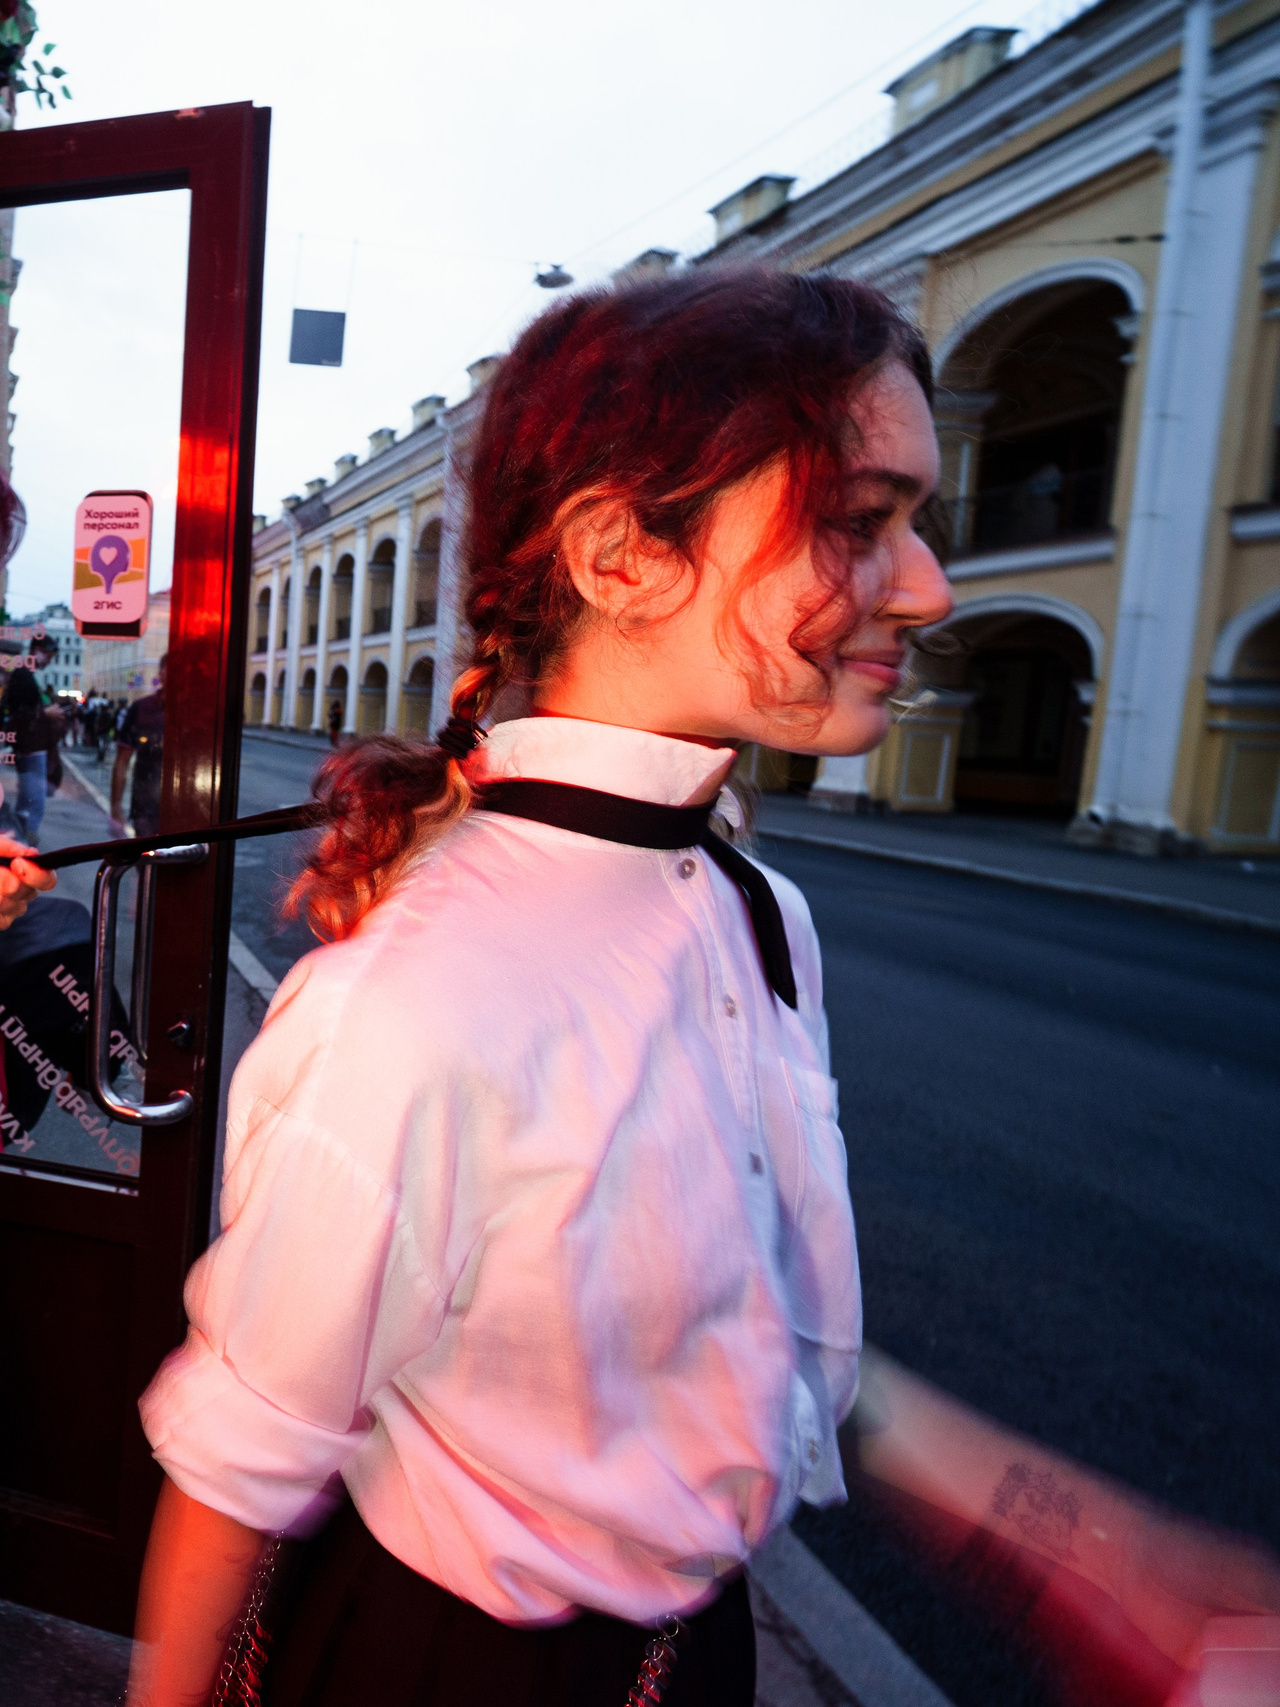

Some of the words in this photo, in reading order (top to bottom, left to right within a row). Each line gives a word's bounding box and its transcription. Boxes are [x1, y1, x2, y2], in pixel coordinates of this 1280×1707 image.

[84, 508, 139, 522] Хороший
[83, 521, 140, 532] персонал
[93, 600, 122, 610] 2ГИС
